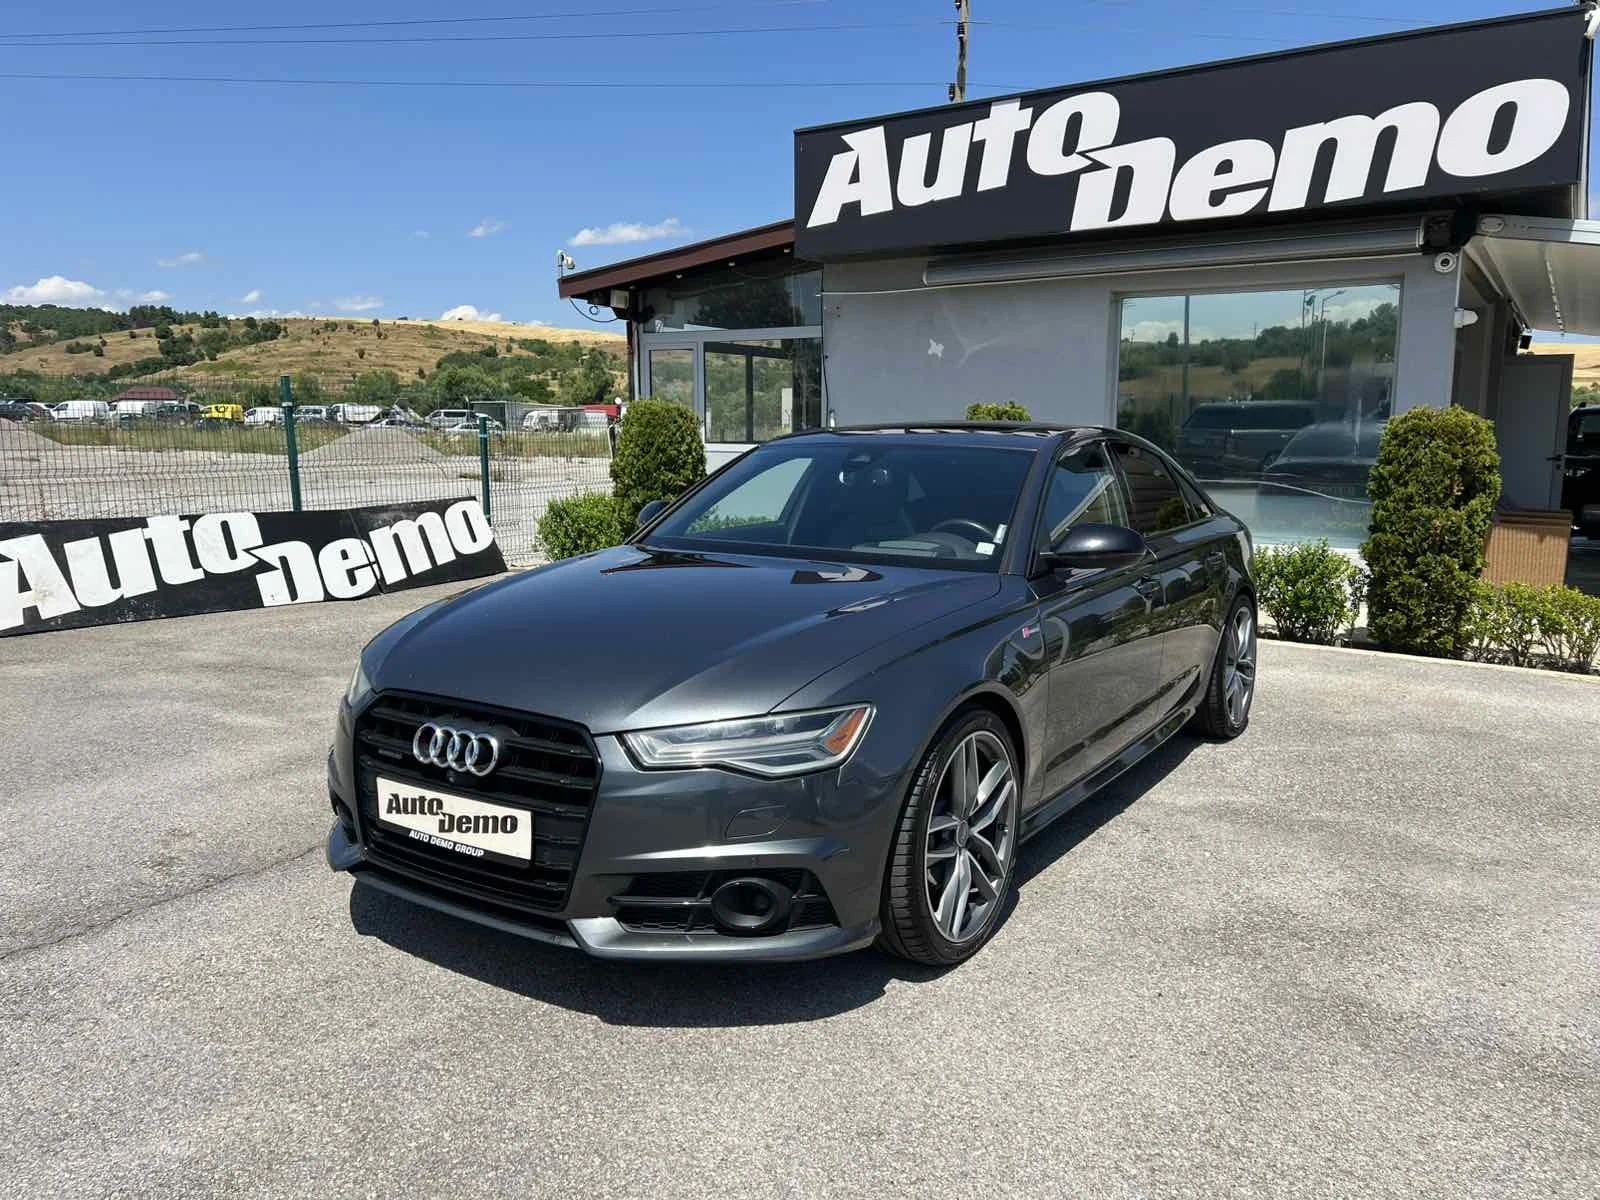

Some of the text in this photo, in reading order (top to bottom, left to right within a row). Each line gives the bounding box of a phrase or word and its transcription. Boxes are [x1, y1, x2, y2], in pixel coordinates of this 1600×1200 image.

[806, 78, 1570, 232] Auto Demo
[0, 500, 495, 631] Auto Demo
[386, 793, 518, 834] Auto Demo
[409, 829, 485, 857] AUTO DEMO GROUP
